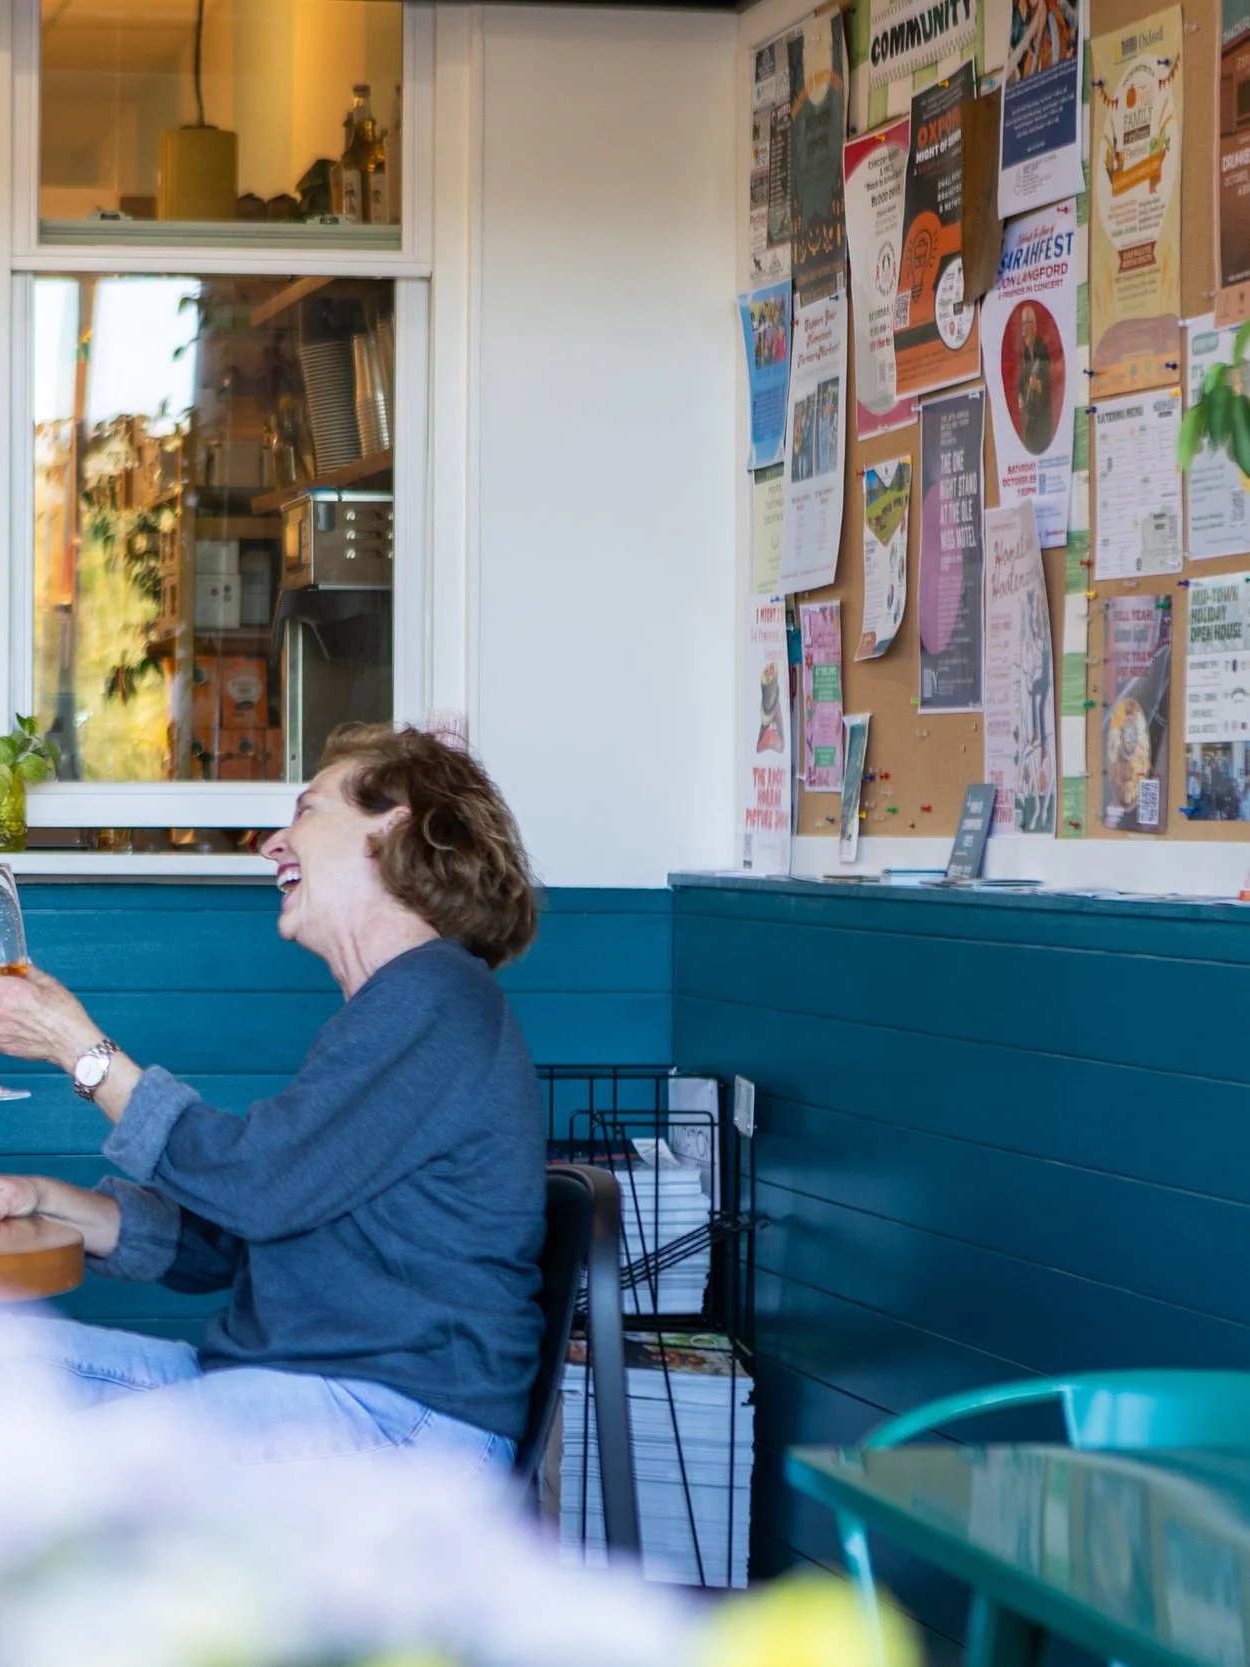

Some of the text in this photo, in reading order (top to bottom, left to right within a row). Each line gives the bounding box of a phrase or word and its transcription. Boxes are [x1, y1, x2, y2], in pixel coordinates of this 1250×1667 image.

[871, 0, 971, 66] COMMUNITY
[918, 105, 961, 148] OXFOR
[916, 145, 938, 164] NIGHT
[940, 139, 948, 153] OF
[998, 231, 1073, 276] SARAHFEST
[1016, 263, 1068, 286] LANGFORD
[1033, 279, 1063, 292] CONCERT
[1007, 462, 1036, 475] SATURDAY
[958, 471, 977, 496] STAND
[1192, 585, 1239, 605] MID-TOWN
[1191, 605, 1227, 624] HOLIDAY
[1190, 622, 1242, 642] OPEN HOUSE
